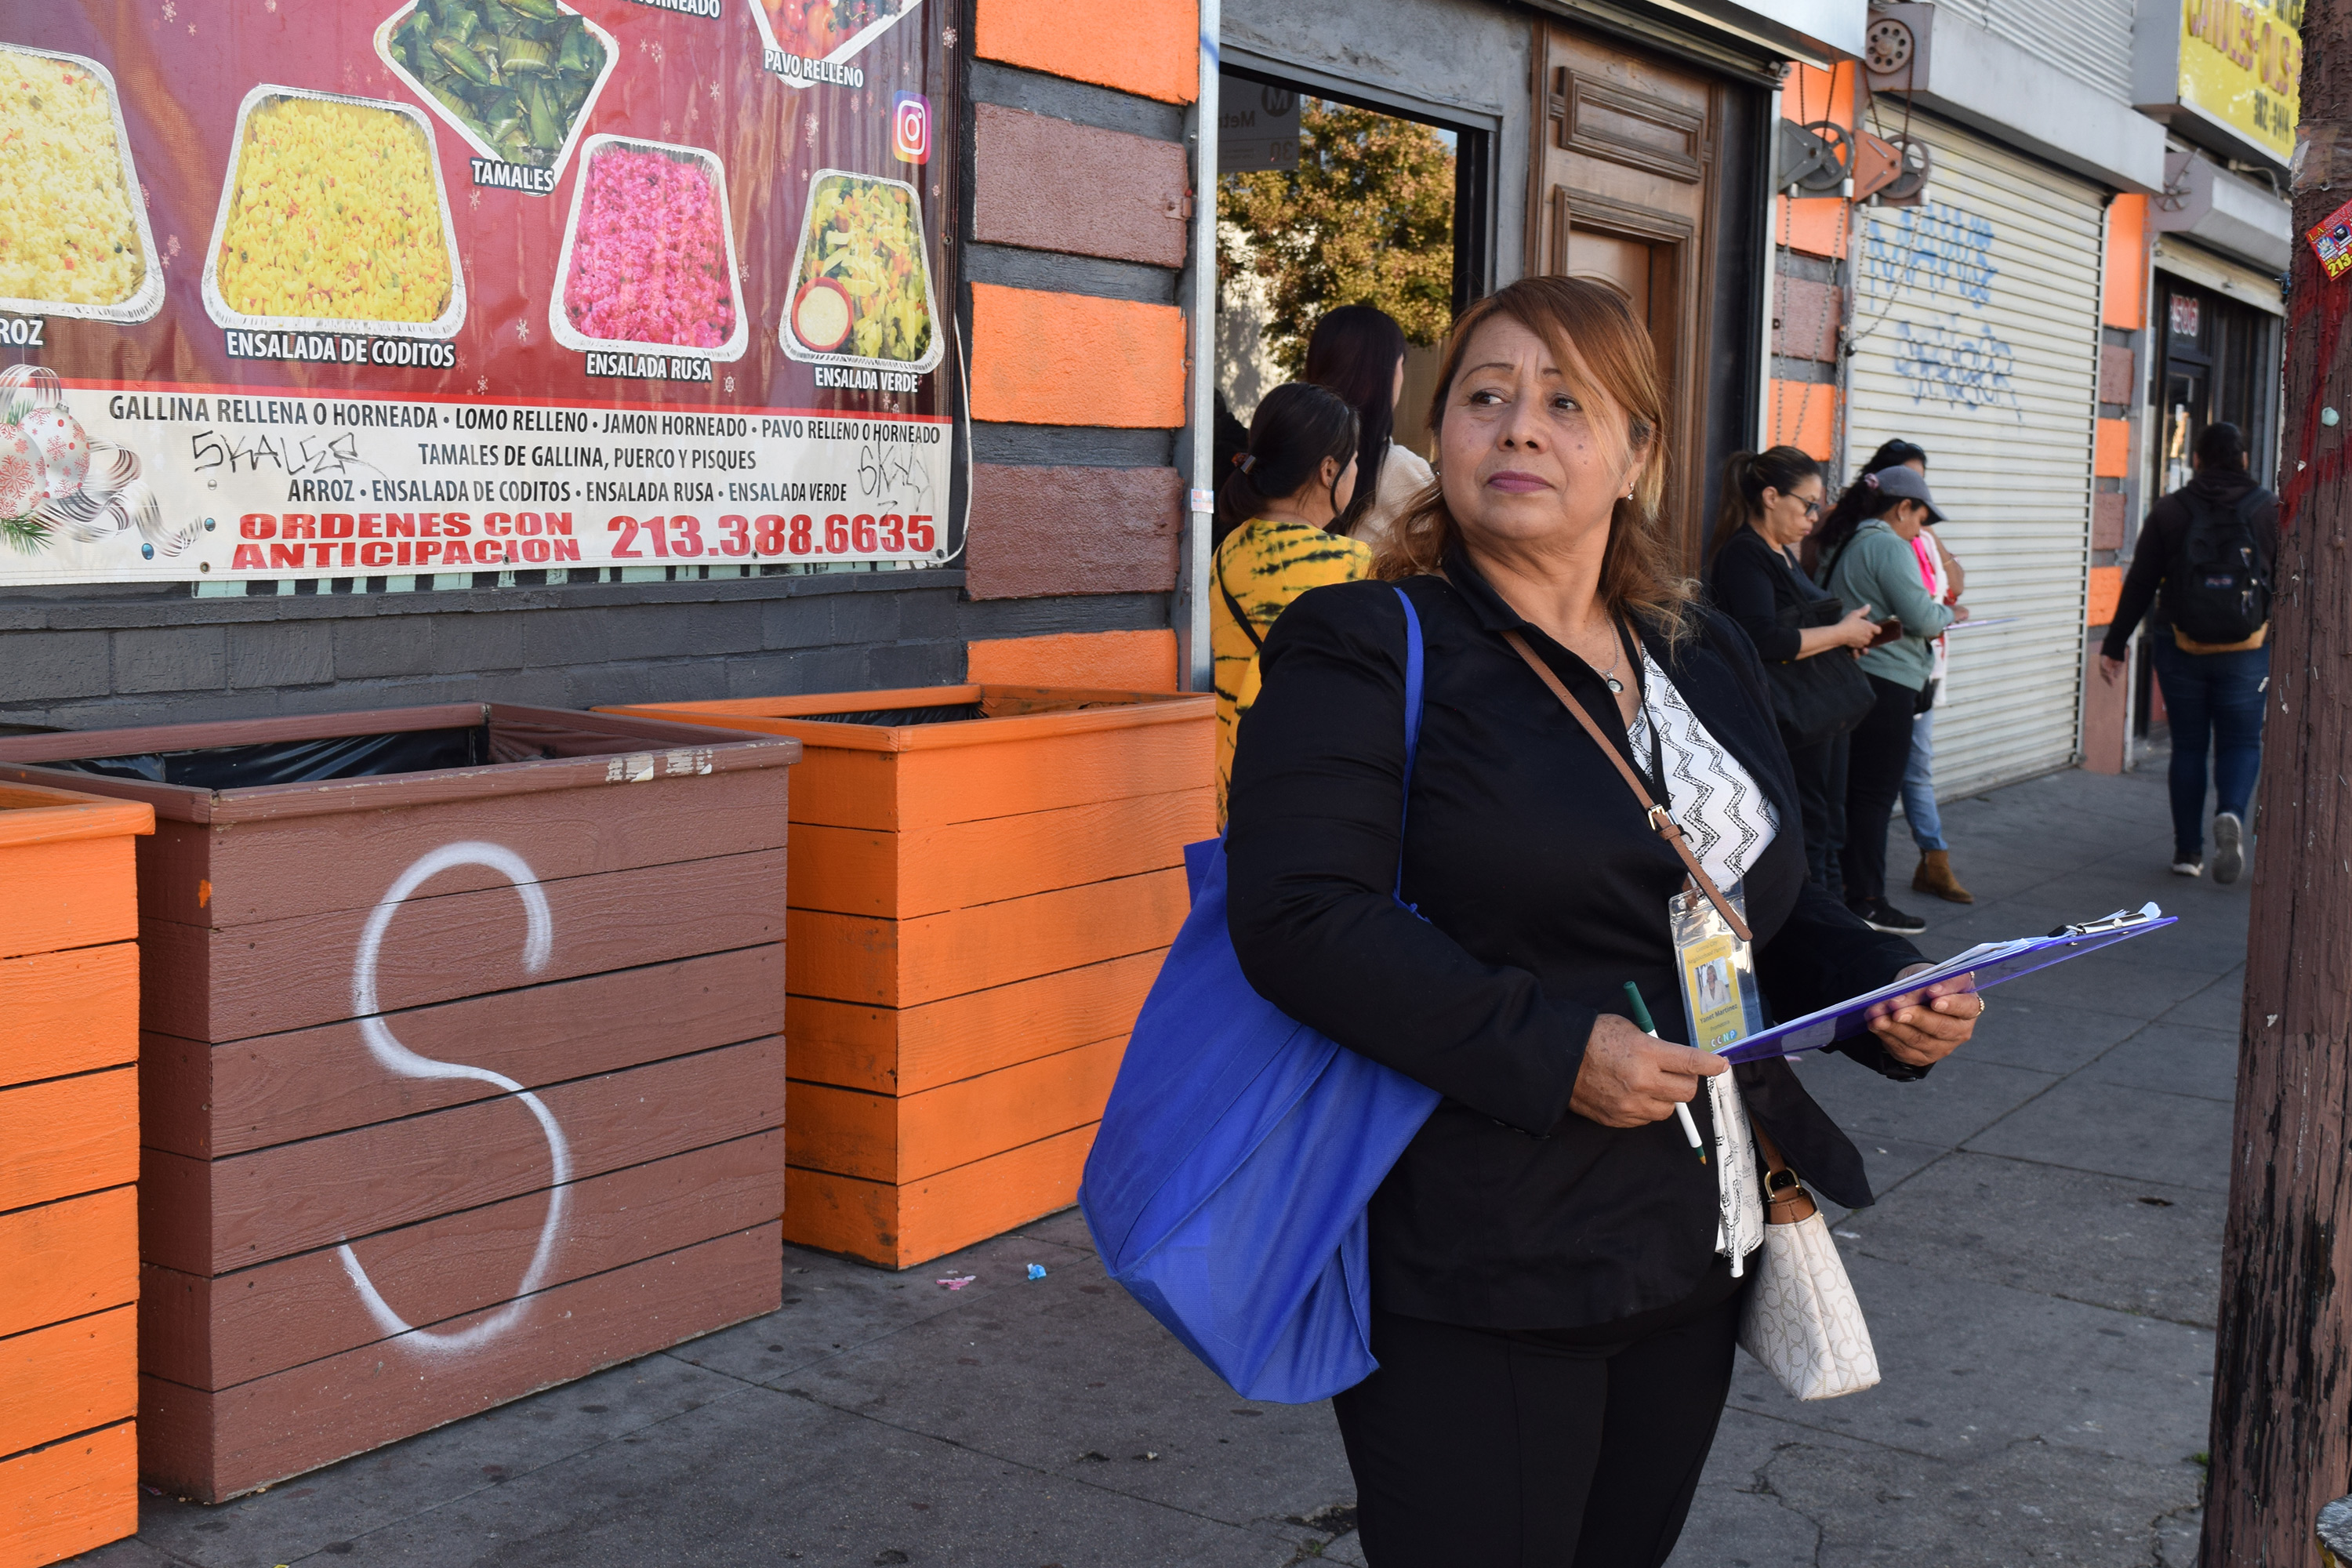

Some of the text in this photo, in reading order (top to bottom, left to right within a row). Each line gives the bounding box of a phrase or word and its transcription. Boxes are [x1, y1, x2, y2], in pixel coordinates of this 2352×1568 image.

[764, 49, 864, 88] PAVO RELLENO
[471, 160, 554, 191] TAMALES
[227, 331, 455, 367] ENSALADA DE CODITOS
[586, 353, 713, 381] ENSALADA RUSA
[815, 367, 918, 393] ENSALADA VERDE
[109, 395, 940, 444] GALLINA RELLENA O HORNEADA LOMO RELLENO JAMON HORNEADO PAVO RELLENO O HORNEADO
[418, 443, 757, 471] TAMALES DE GALLINA, PUERCO Y PISQUES
[287, 479, 848, 503] ARROZ ENSALADA DE CODITOS ENSALADA RUSA ENSALADA VERDE
[239, 512, 572, 540] ORDENES CON
[607, 514, 935, 558] 213.388.6635
[230, 539, 582, 570] ANTICIPACION
[1700, 1013, 1715, 1024] Yanet
[339, 840, 573, 1356] S
